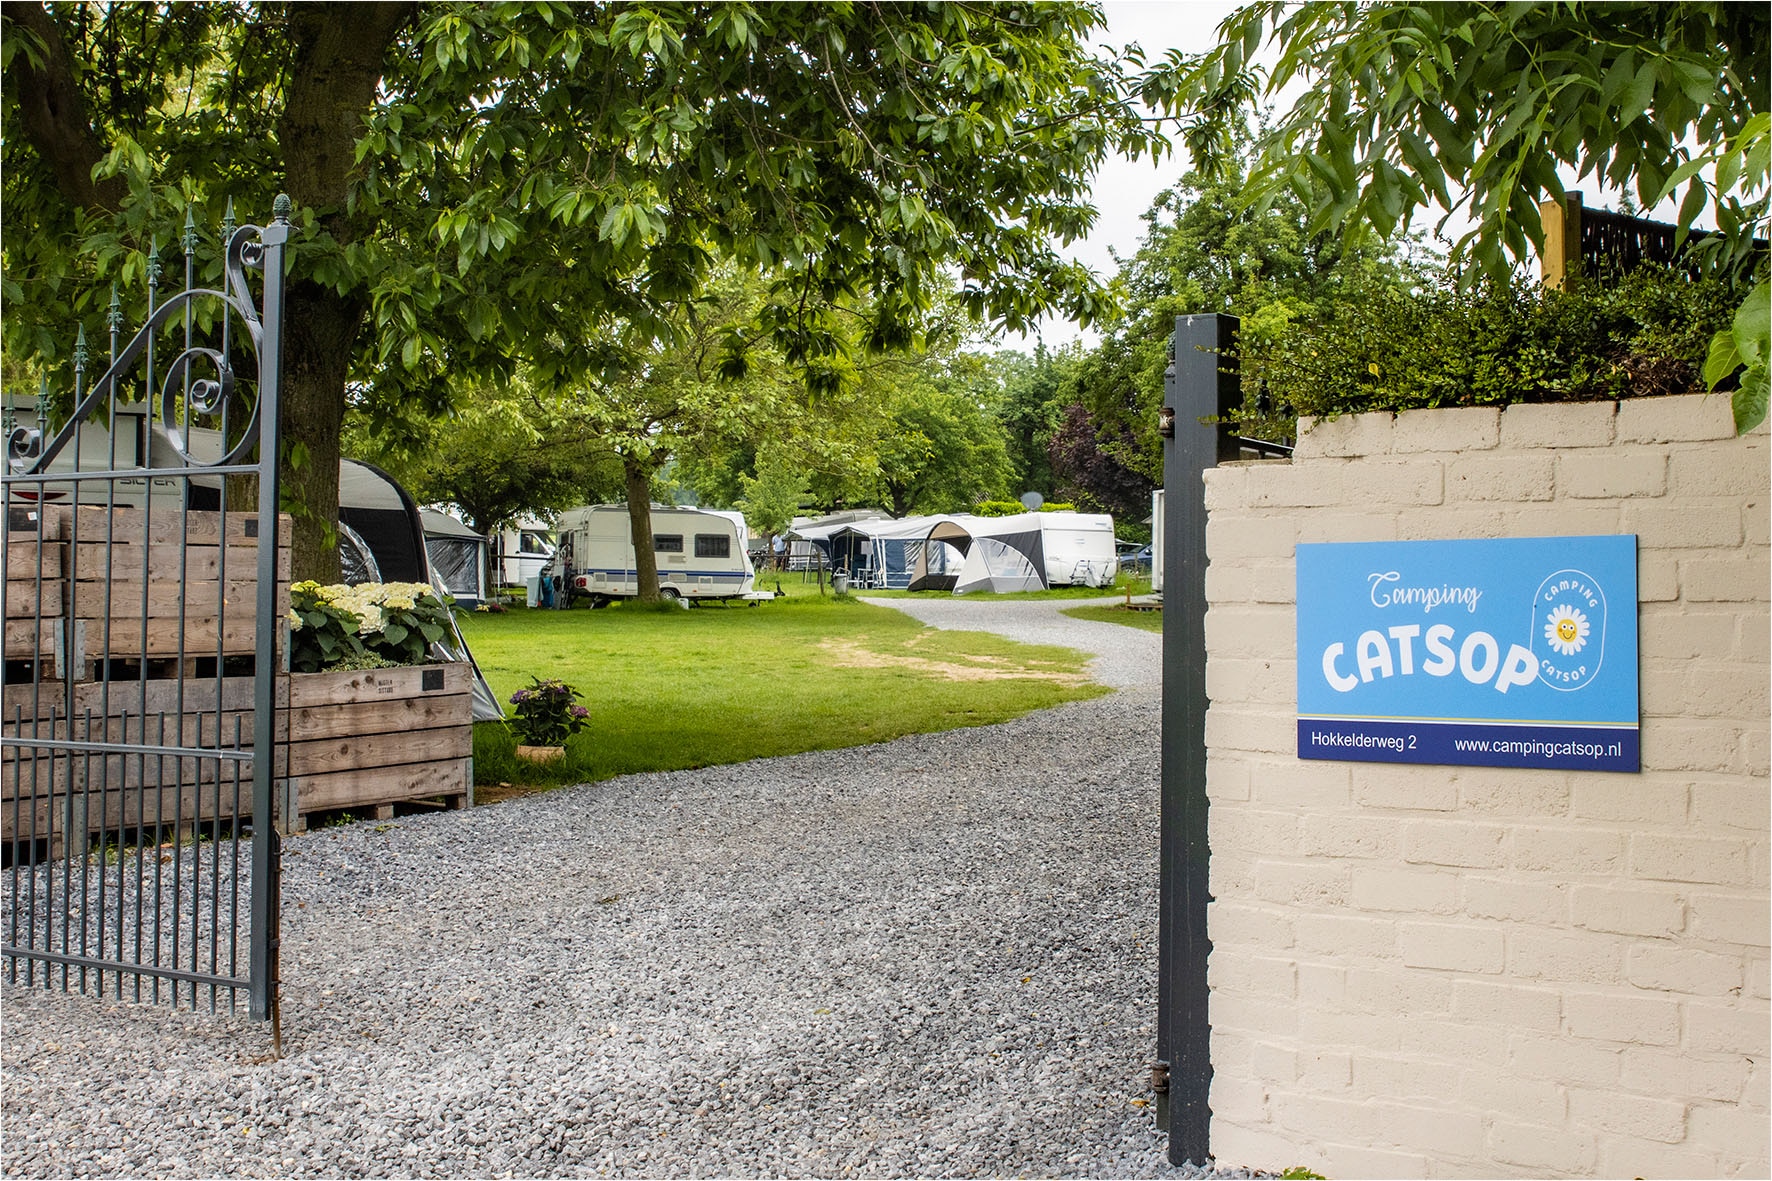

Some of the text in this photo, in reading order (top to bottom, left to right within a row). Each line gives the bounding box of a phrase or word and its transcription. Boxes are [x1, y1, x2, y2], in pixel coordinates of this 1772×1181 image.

[120, 477, 176, 487] SILER
[1368, 571, 1483, 613] Camping
[1544, 580, 1598, 608] CAMPING
[1322, 624, 1539, 694] CATSOP
[1541, 659, 1586, 682] CATSOP
[1311, 731, 1417, 751] Hokkelderweg 2
[1455, 739, 1622, 758] www.campingcatsop.nl
